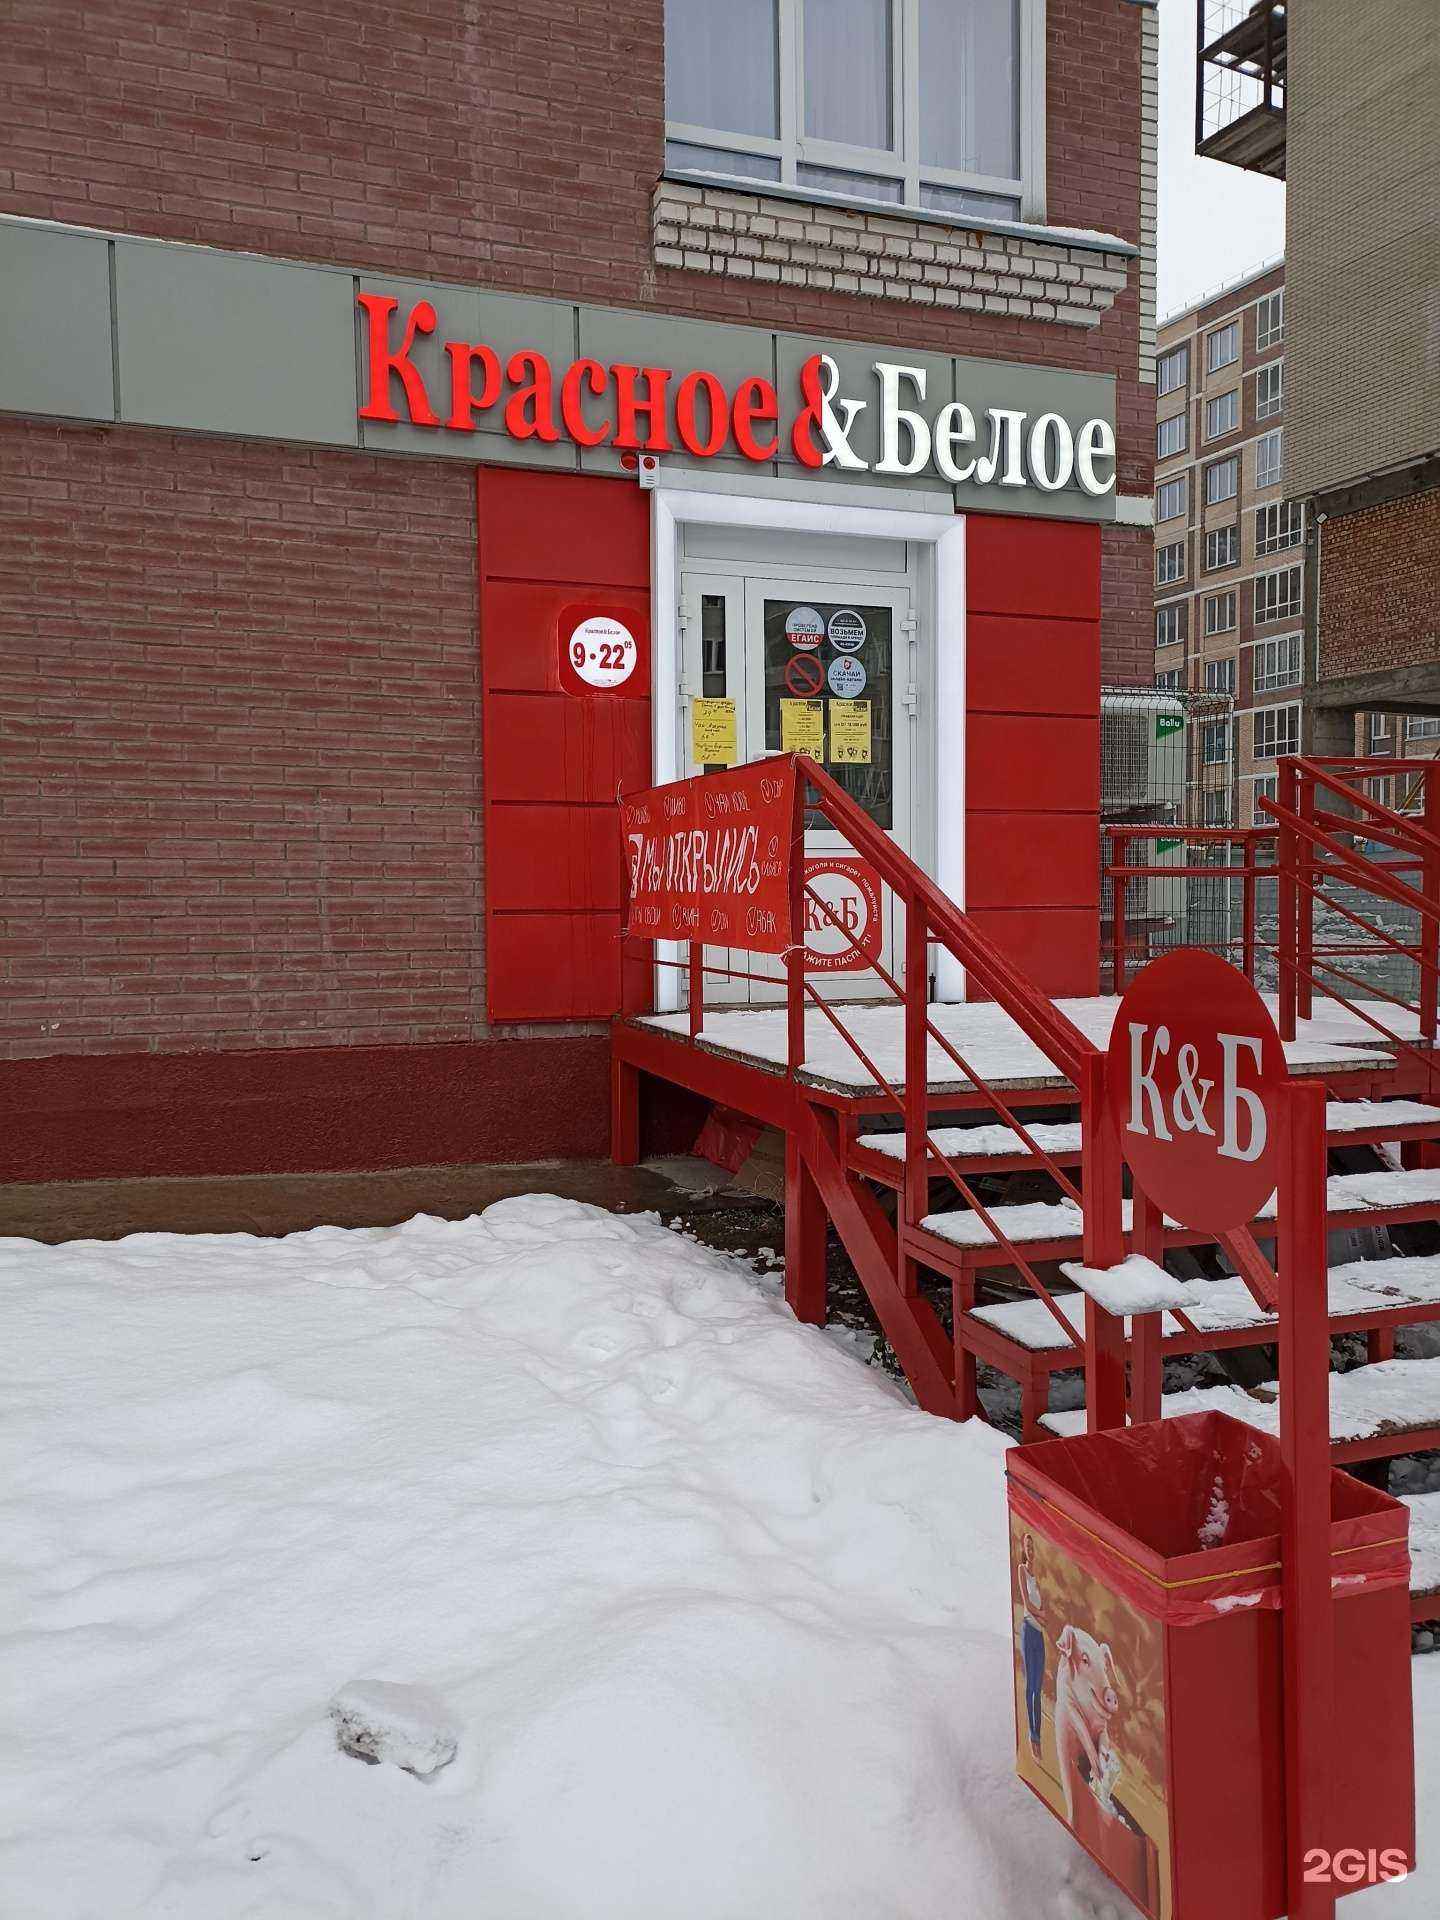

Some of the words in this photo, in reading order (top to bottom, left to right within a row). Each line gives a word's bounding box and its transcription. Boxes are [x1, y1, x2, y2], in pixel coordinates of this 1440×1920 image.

[791, 634, 819, 643] ЕГАИС
[1159, 718, 1180, 727] Ballu
[804, 861, 828, 875] коголя
[835, 862, 861, 878] сигарет
[862, 878, 879, 922] пожалуйста
[1126, 1022, 1267, 1162] К&Б
